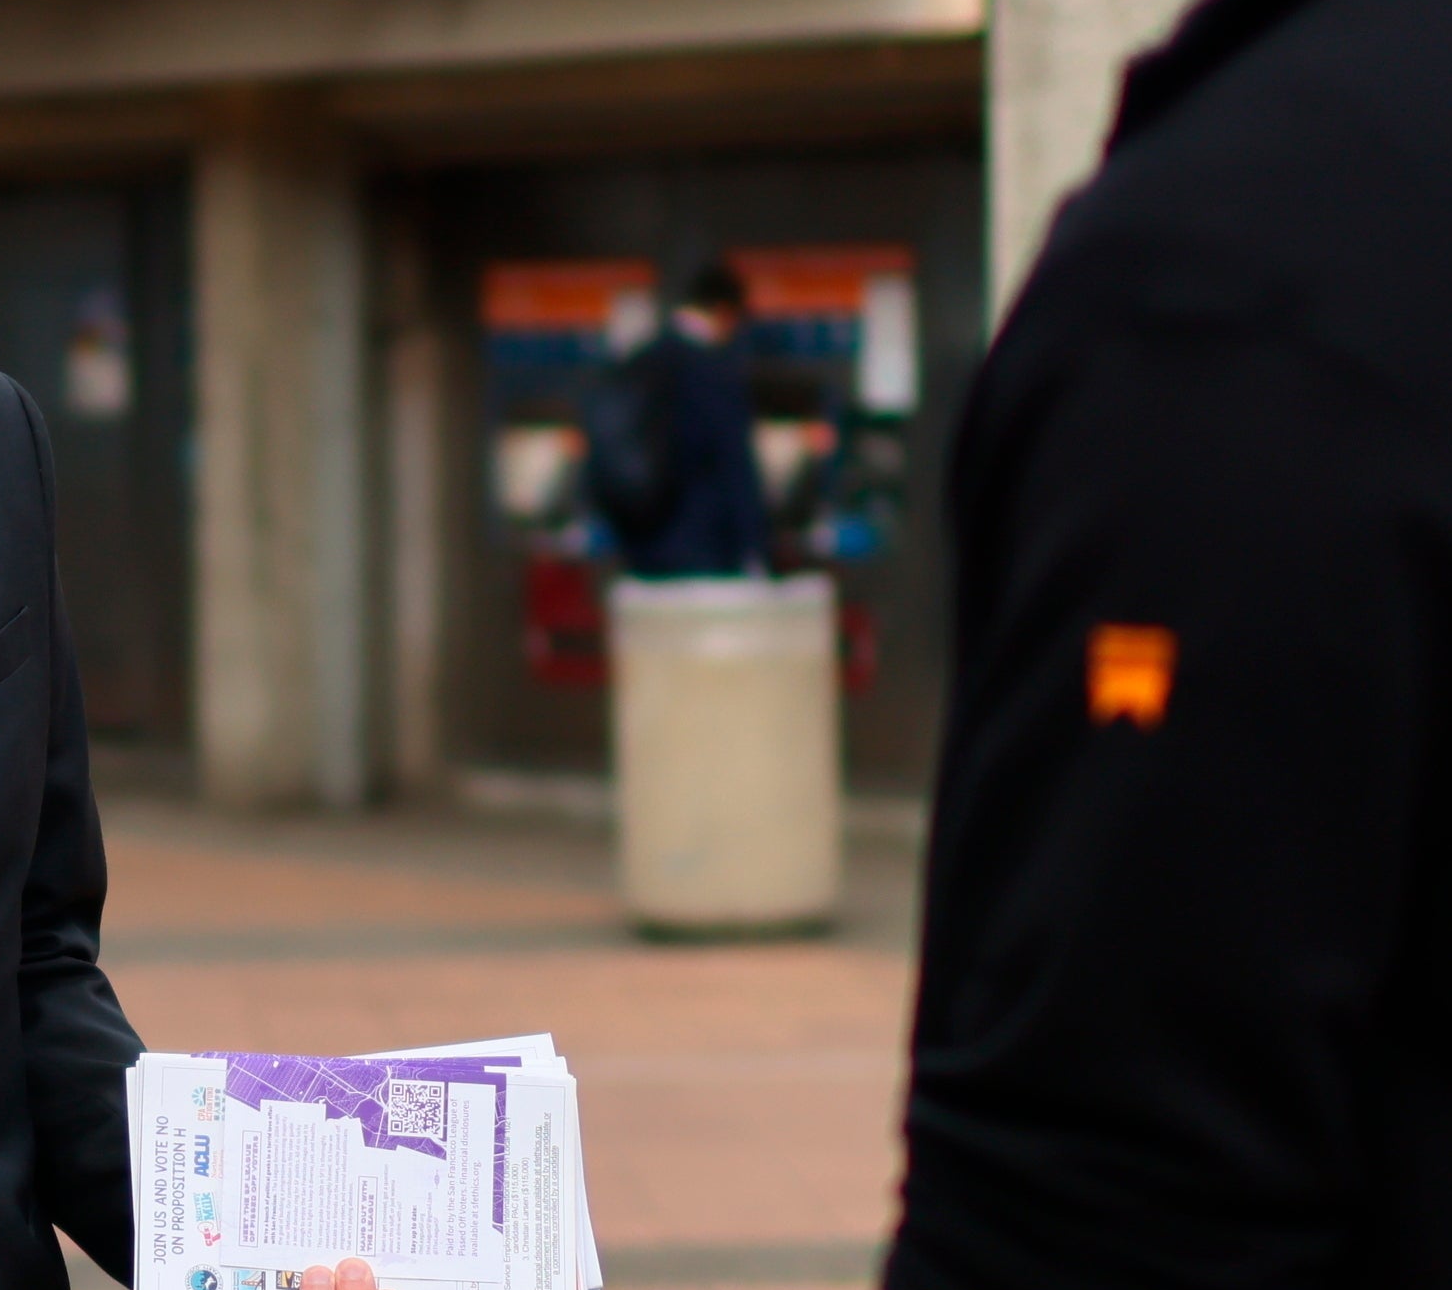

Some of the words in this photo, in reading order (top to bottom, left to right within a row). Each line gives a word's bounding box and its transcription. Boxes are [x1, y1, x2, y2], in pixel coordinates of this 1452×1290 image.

[449, 1098, 458, 1107] of
[155, 1115, 168, 1134] NO
[197, 1108, 205, 1121] CPA
[449, 1108, 459, 1137] League
[460, 1100, 469, 1145] disclosures
[172, 1128, 186, 1137] H
[154, 1140, 168, 1173] VOTE
[193, 1133, 210, 1178] ACLU
[447, 1140, 456, 1178] Francisco
[459, 1147, 468, 1184] Financial
[542, 1163, 550, 1173] by
[154, 1178, 167, 1205] AND
[171, 1142, 186, 1230] PROPOSITION
[447, 1180, 455, 1195] San
[551, 1188, 559, 1196] by
[199, 1191, 214, 1221] Milk
[446, 1197, 455, 1210] the
[459, 1187, 467, 1214] Voters.
[521, 1196, 529, 1220] Larsen
[153, 1210, 167, 1228] US
[446, 1212, 456, 1222] by
[458, 1216, 466, 1228] Off
[470, 1209, 478, 1218] at
[411, 1230, 417, 1238] up
[446, 1224, 454, 1236] for
[469, 1220, 478, 1257] available
[511, 1220, 519, 1253] candidate
[153, 1233, 166, 1264] JOIN
[170, 1235, 184, 1254] ON
[445, 1238, 454, 1255] Paid
[458, 1230, 466, 1256] Pissed
[504, 1225, 512, 1262] Employees
